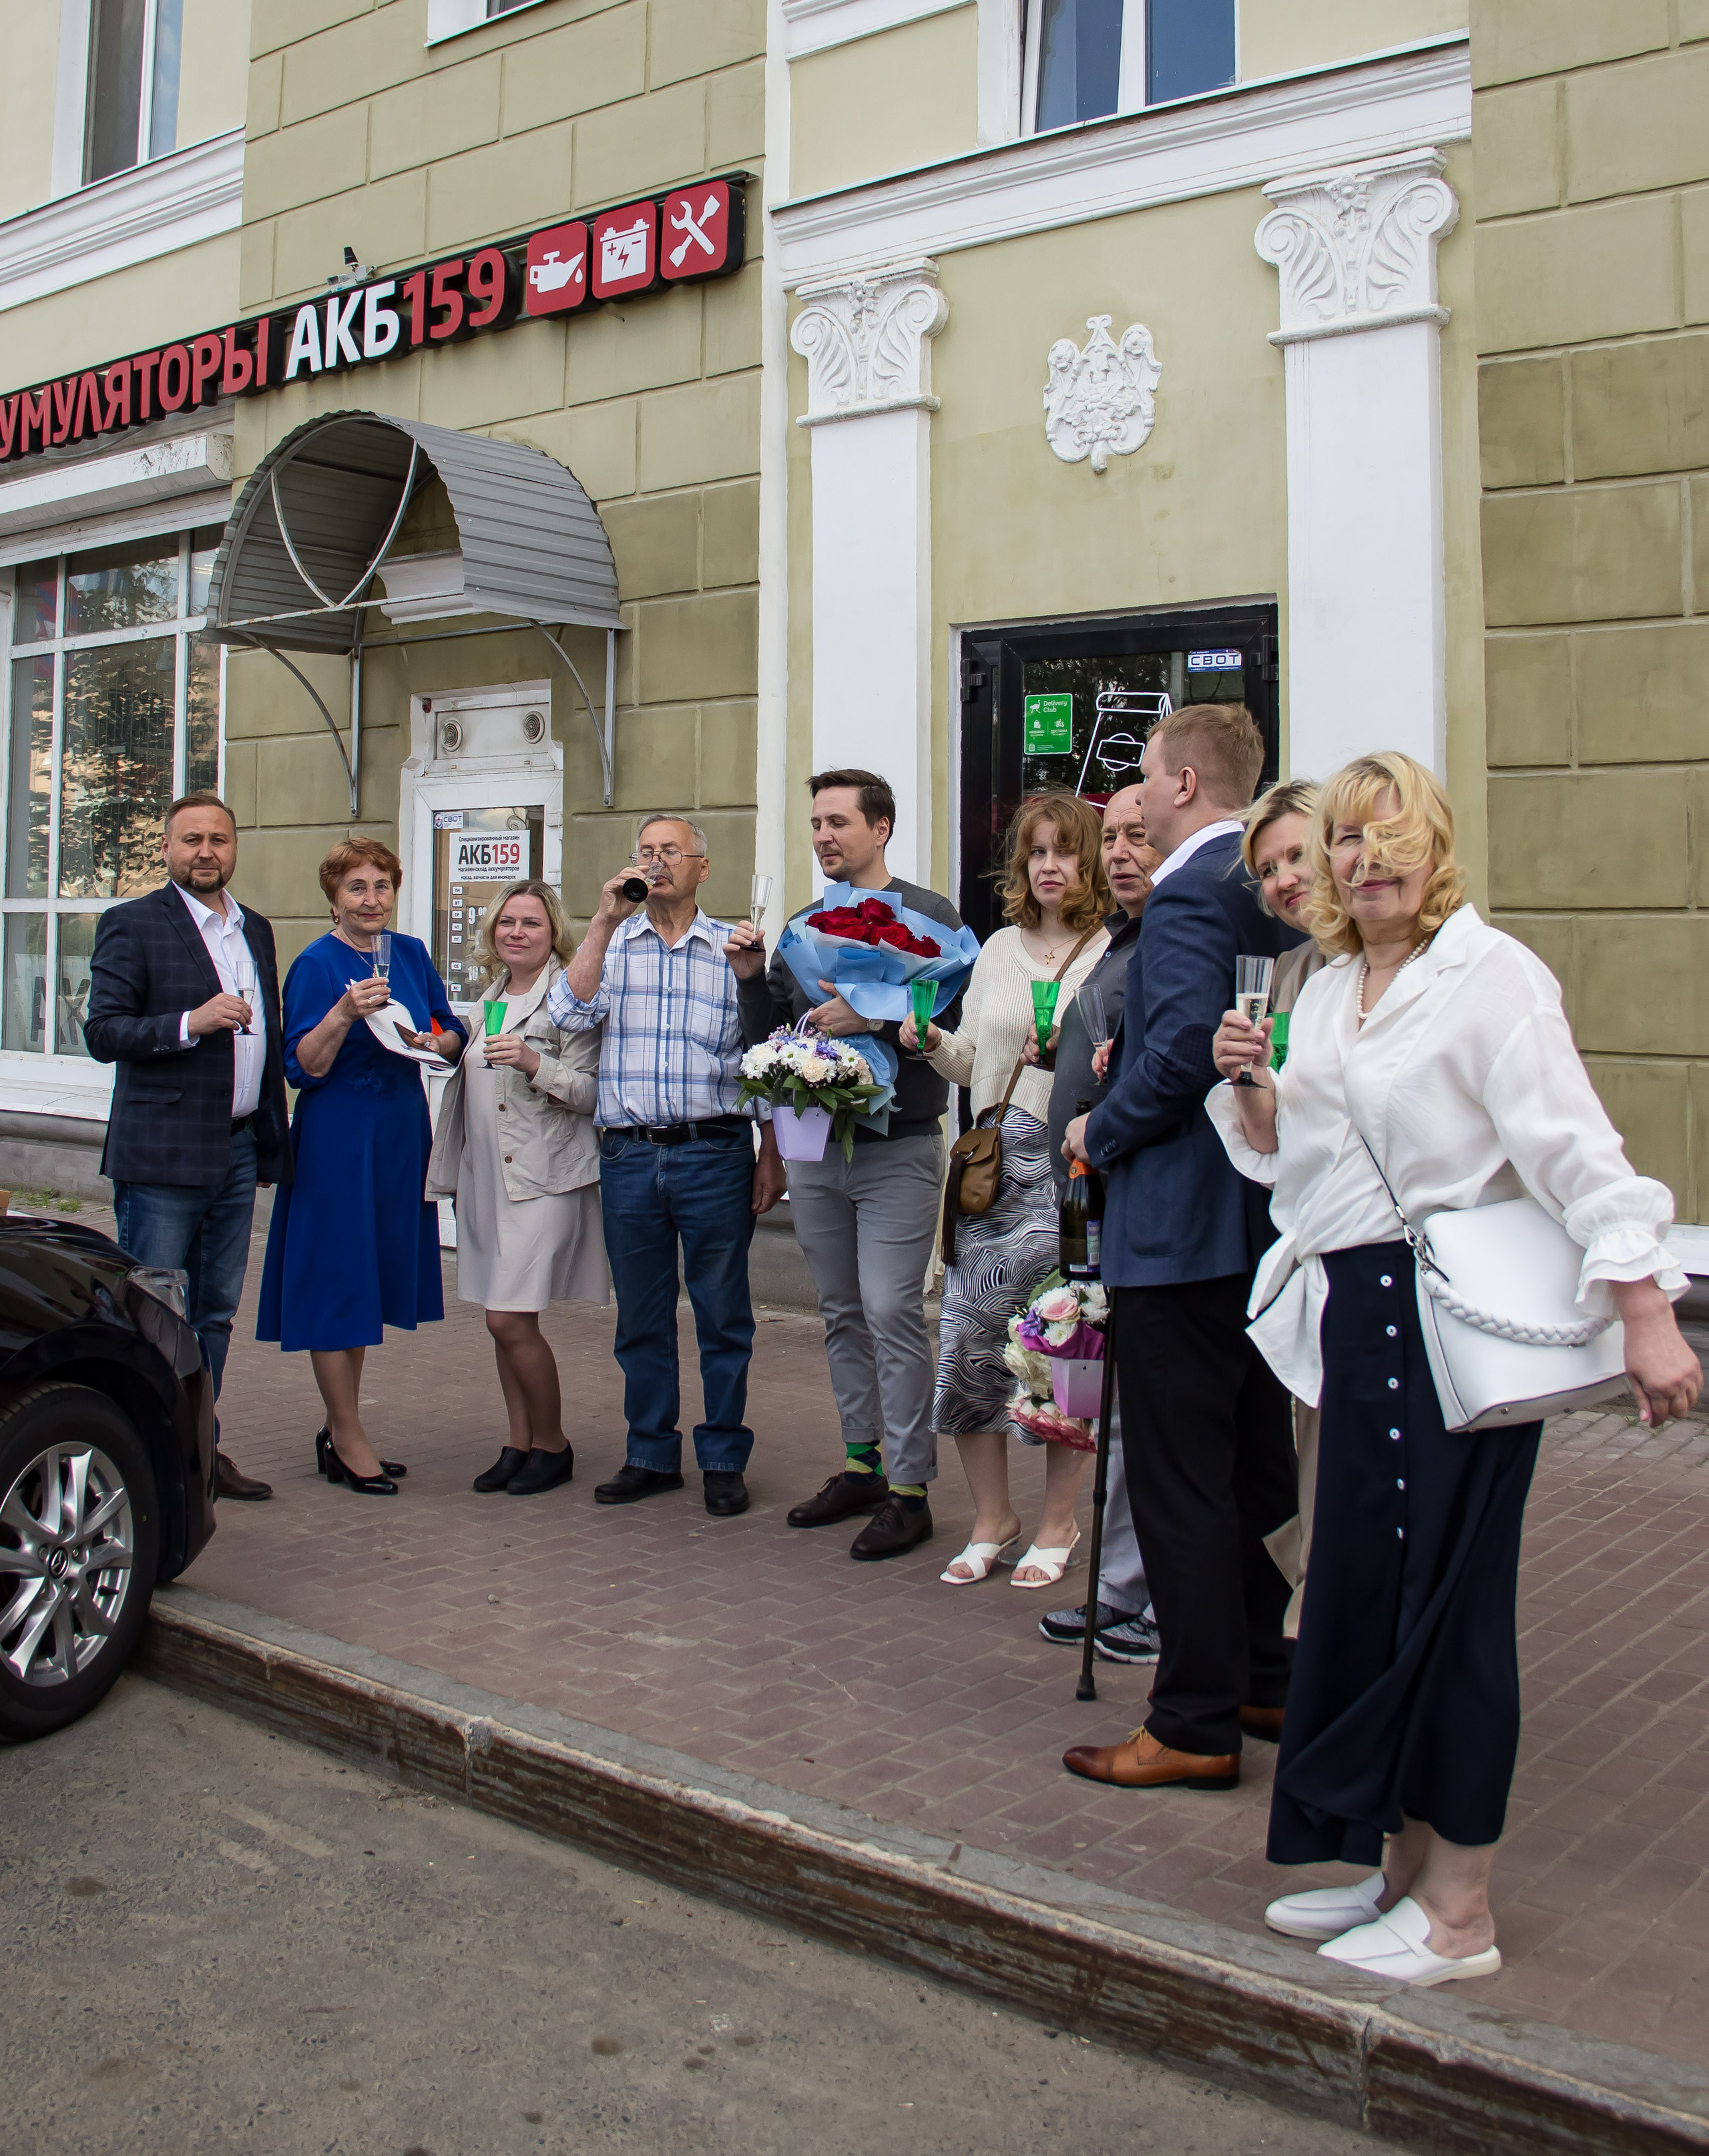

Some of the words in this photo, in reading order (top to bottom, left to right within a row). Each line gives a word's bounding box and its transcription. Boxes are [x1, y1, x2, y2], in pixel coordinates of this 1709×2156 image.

[286, 248, 505, 379] АКБ159
[1191, 654, 1239, 665] СВОТ
[458, 843, 520, 865] АКБ159
